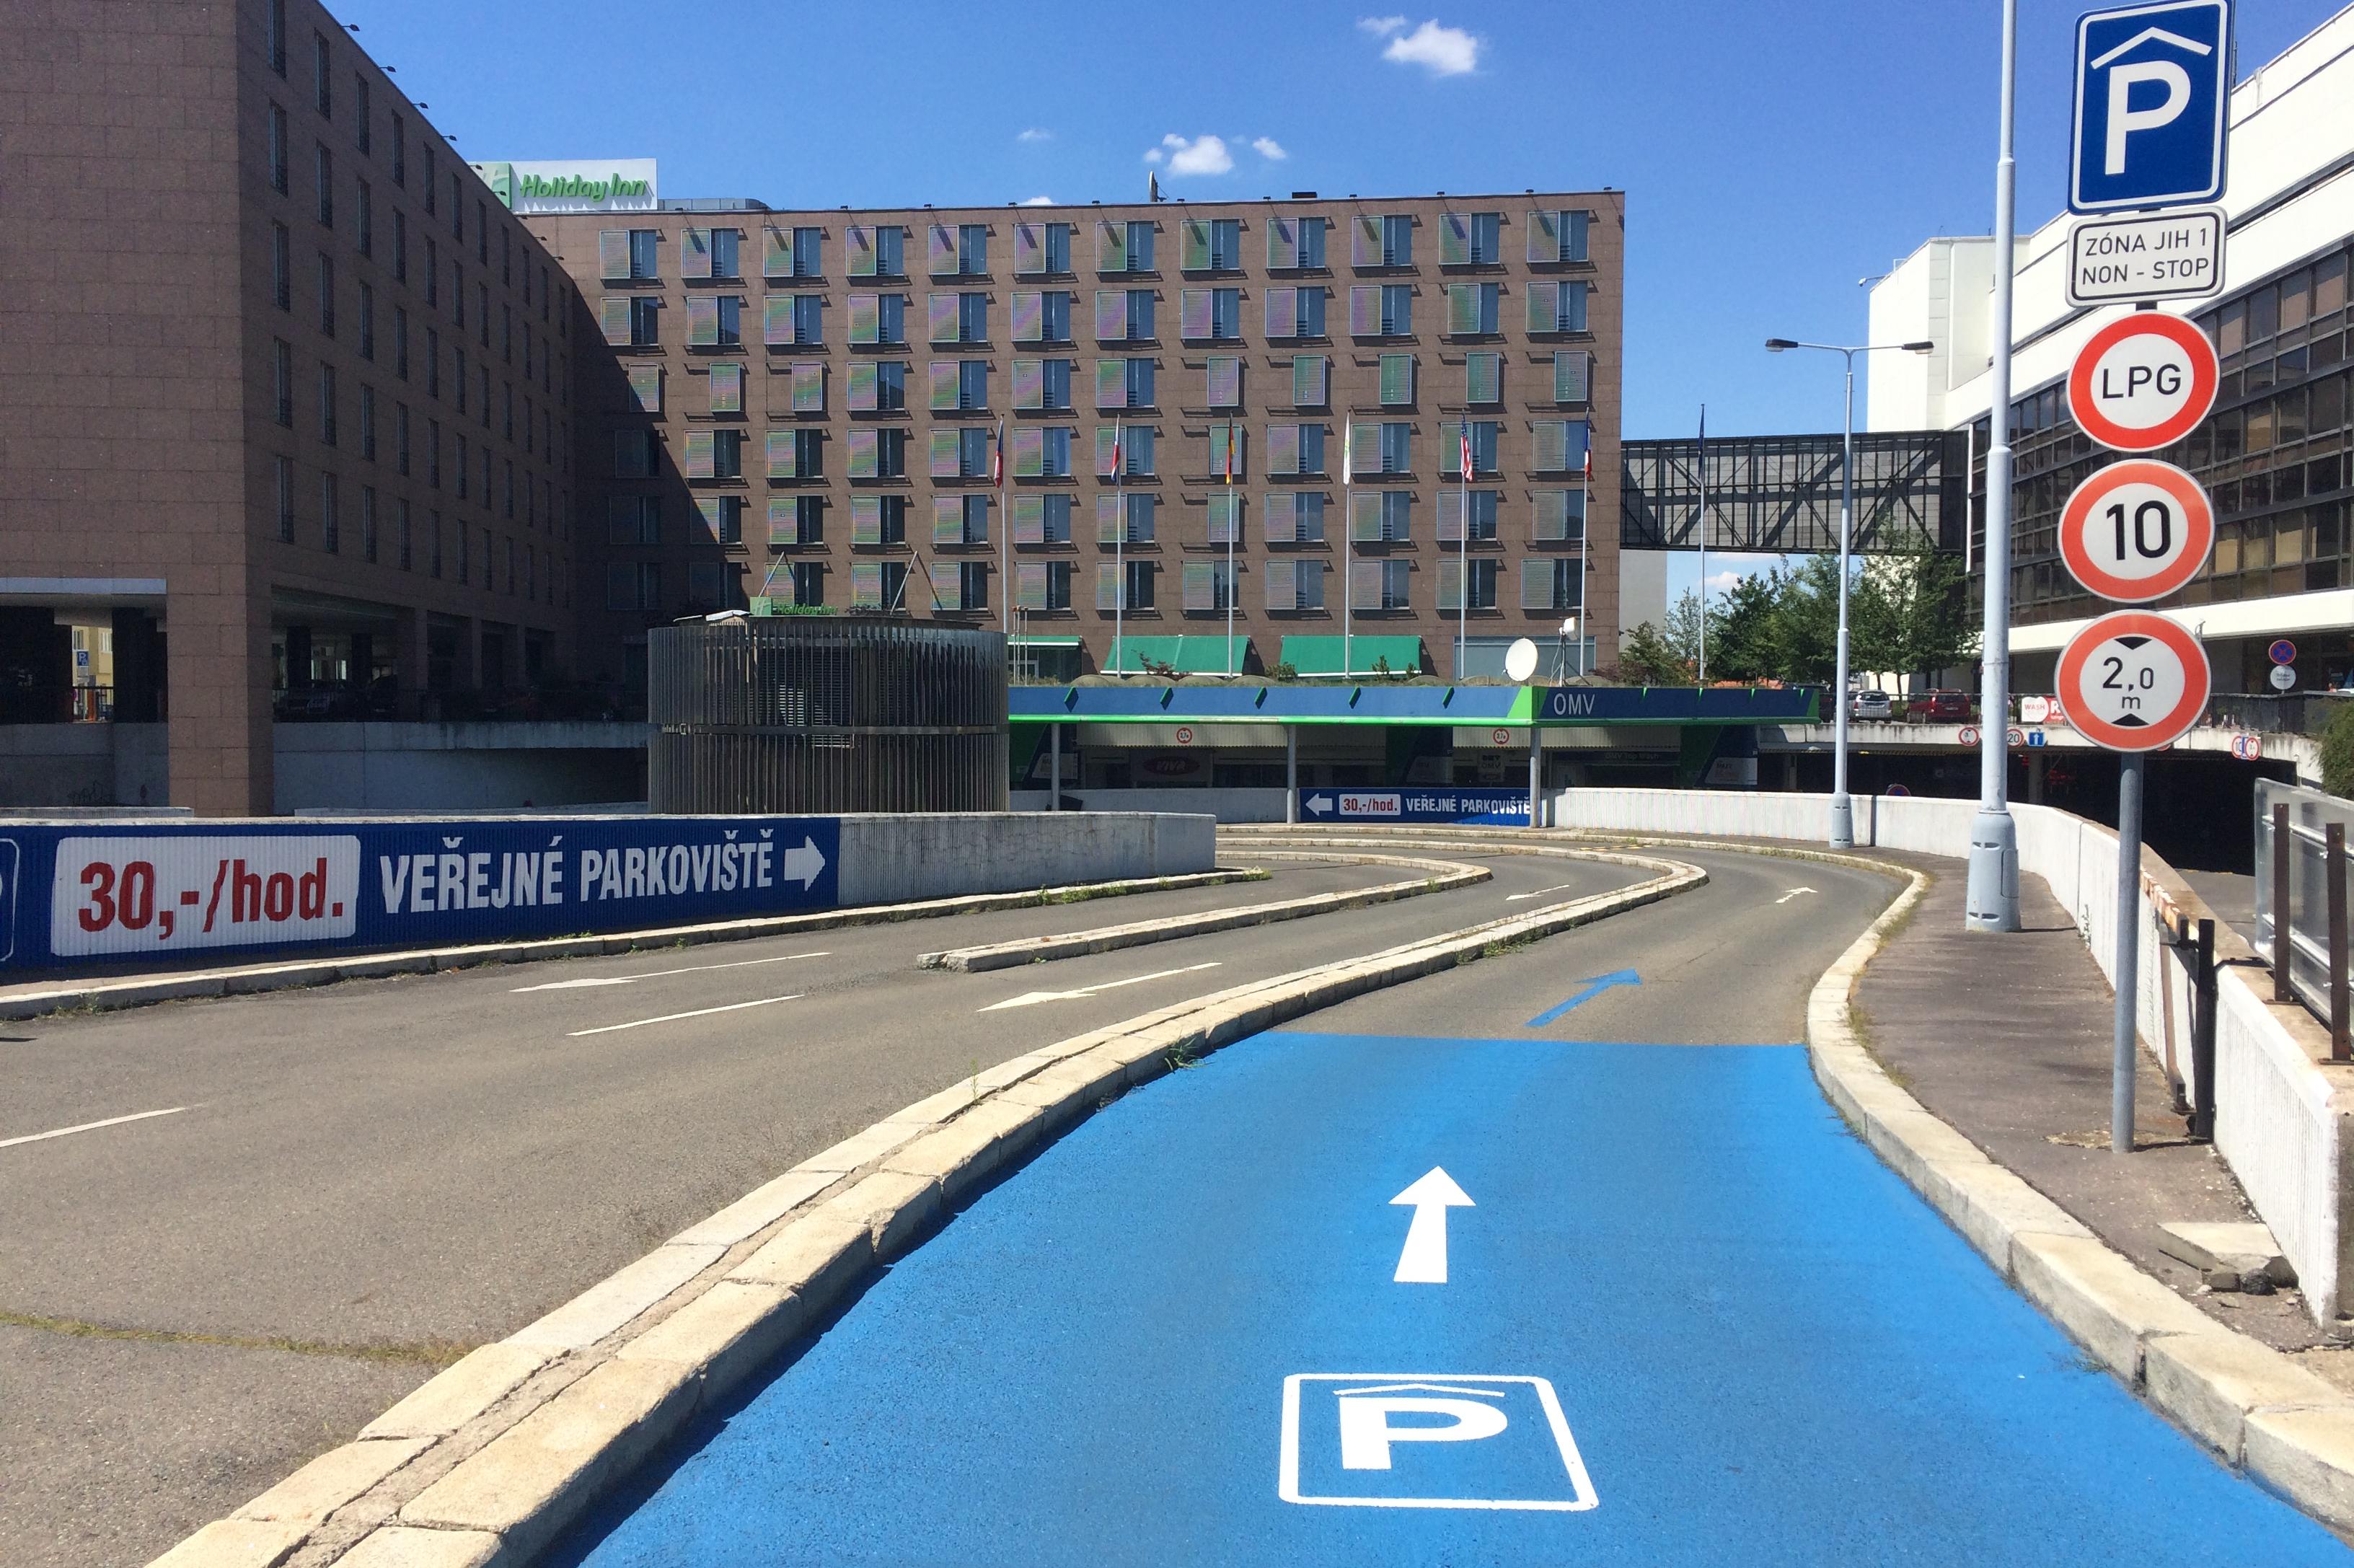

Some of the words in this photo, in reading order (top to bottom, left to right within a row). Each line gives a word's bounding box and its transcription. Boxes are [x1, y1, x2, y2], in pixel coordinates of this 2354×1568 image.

[2105, 61, 2191, 175] P
[520, 174, 607, 202] Holiday
[610, 172, 645, 197] Inn
[2085, 232, 2146, 256] ZÓNA
[2154, 229, 2190, 250] JIH
[2200, 228, 2206, 246] 1
[2083, 264, 2128, 285] NON
[2153, 257, 2209, 279] STOP
[2102, 364, 2182, 399] LPG
[2107, 500, 2171, 560] 10
[777, 603, 818, 615] Holiday
[821, 603, 838, 615] Inn
[2102, 656, 2154, 692] 2,0
[1553, 693, 1595, 715] OMV
[2122, 696, 2141, 709] m
[2008, 734, 2019, 743] 20
[1343, 798, 1398, 813] 30,-/hod.
[1406, 795, 1456, 812] VEŘEJNÉ
[1461, 796, 1530, 814] PARKOVIŠTĚ
[78, 858, 343, 940] 30,-/hod.
[380, 835, 563, 914] VEŘEJNÉ
[580, 828, 774, 902] PARKOVIŠTĚ
[1339, 1397, 1508, 1470] P
